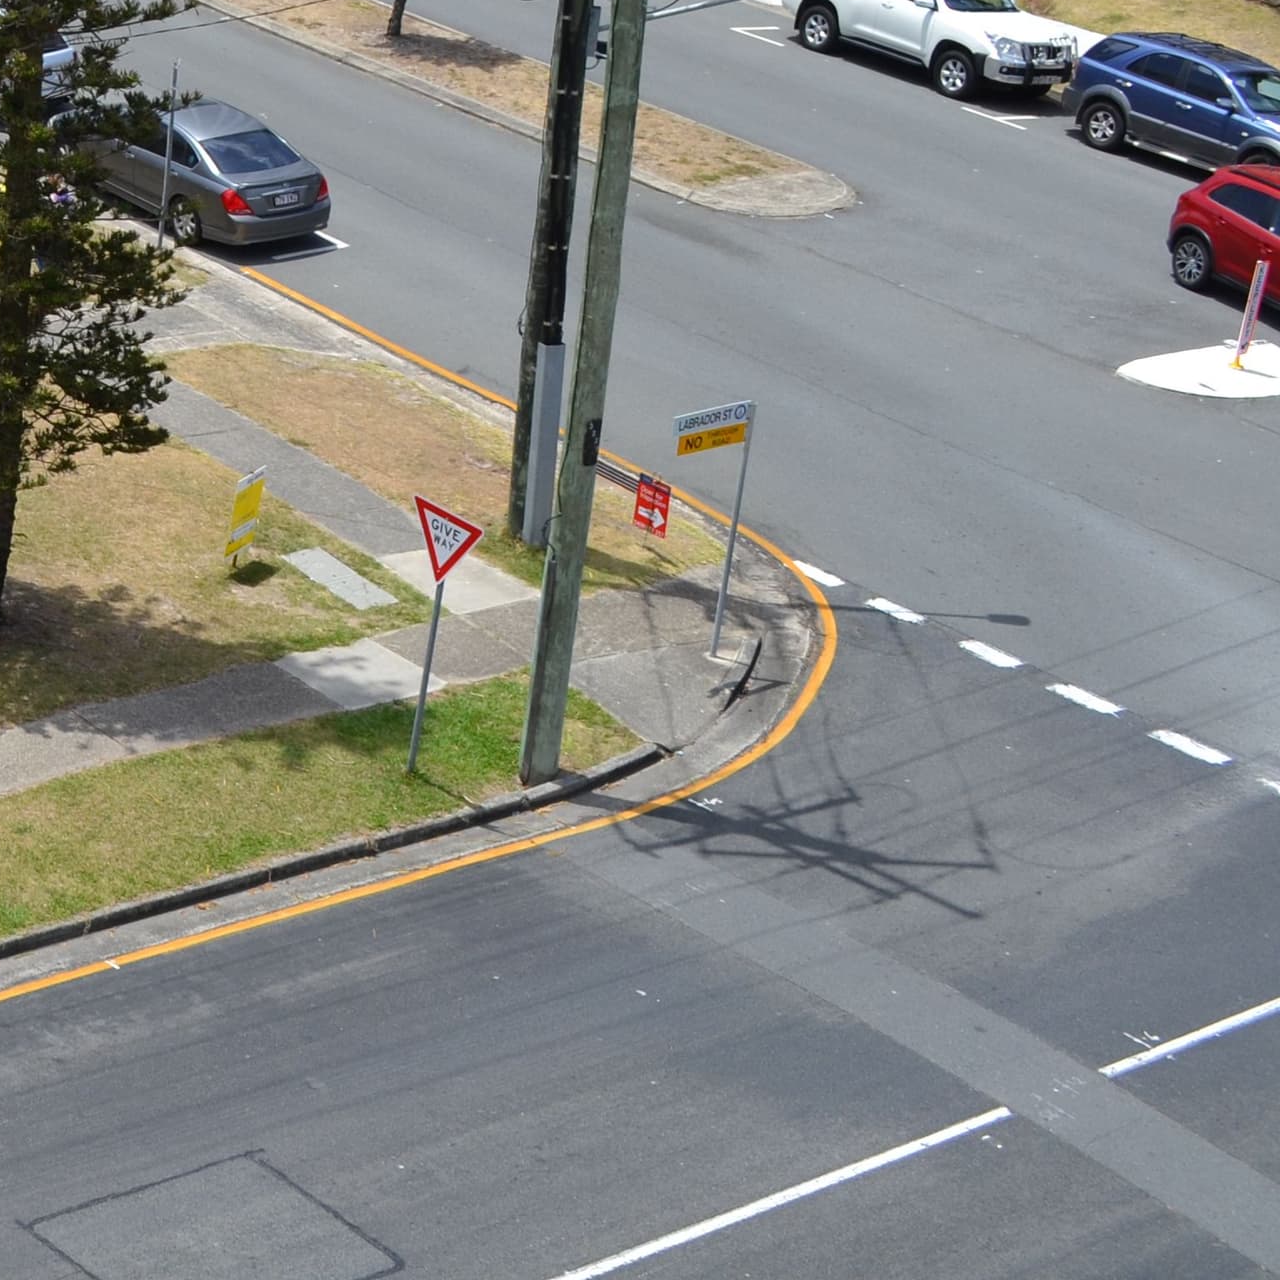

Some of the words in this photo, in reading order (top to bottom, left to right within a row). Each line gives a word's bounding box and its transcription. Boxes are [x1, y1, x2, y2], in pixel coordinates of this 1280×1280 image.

[678, 411, 722, 432] LABRADOR
[722, 408, 734, 422] ST
[684, 436, 704, 451] NO
[431, 518, 461, 543] GIVE
[434, 535, 454, 551] WAY
